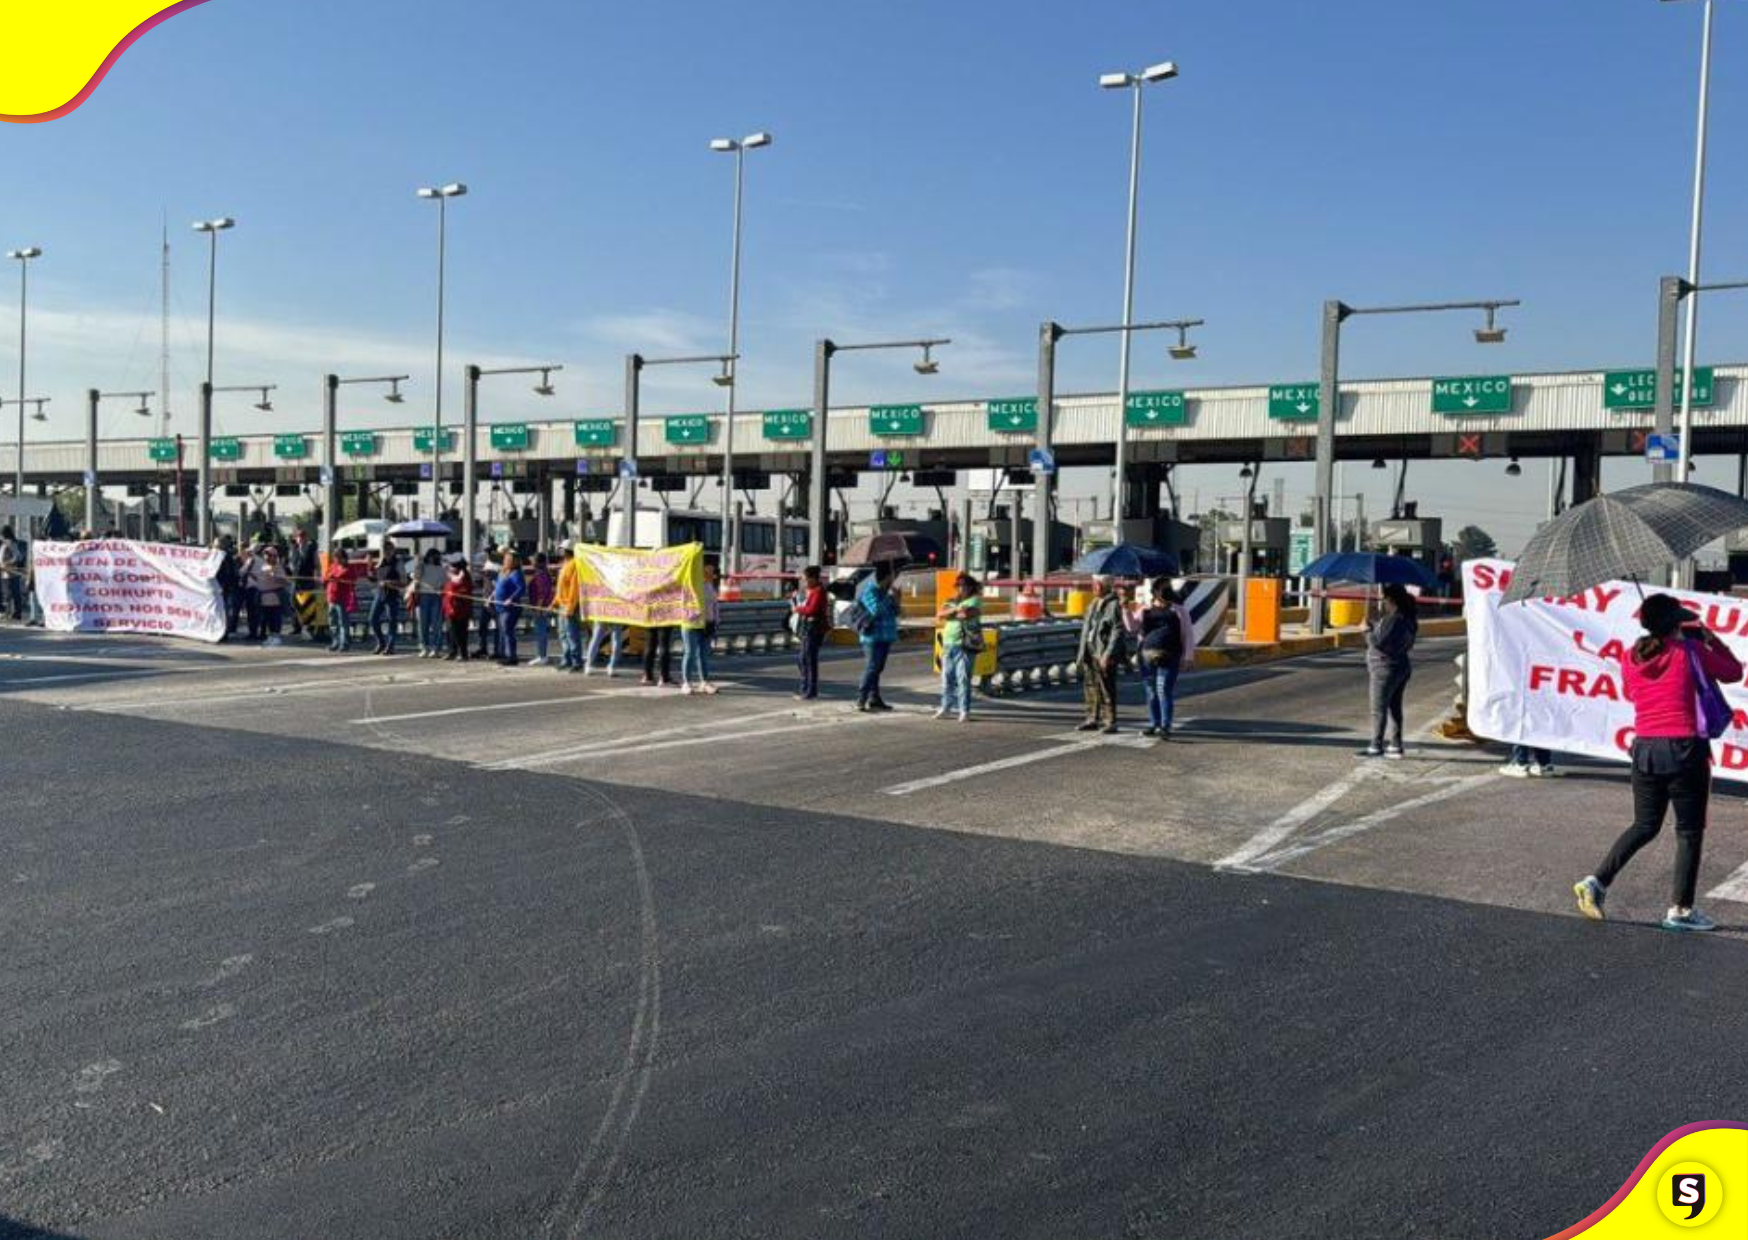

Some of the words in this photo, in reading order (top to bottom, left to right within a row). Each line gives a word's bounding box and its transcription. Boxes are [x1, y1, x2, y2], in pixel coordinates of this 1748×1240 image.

[1436, 381, 1507, 395] MEXICO
[765, 415, 808, 424] MEXICO
[871, 409, 920, 420] MEXICO
[577, 422, 611, 431] MEXICO
[668, 418, 704, 427] MEXICO
[93, 617, 173, 630] SERVICIO
